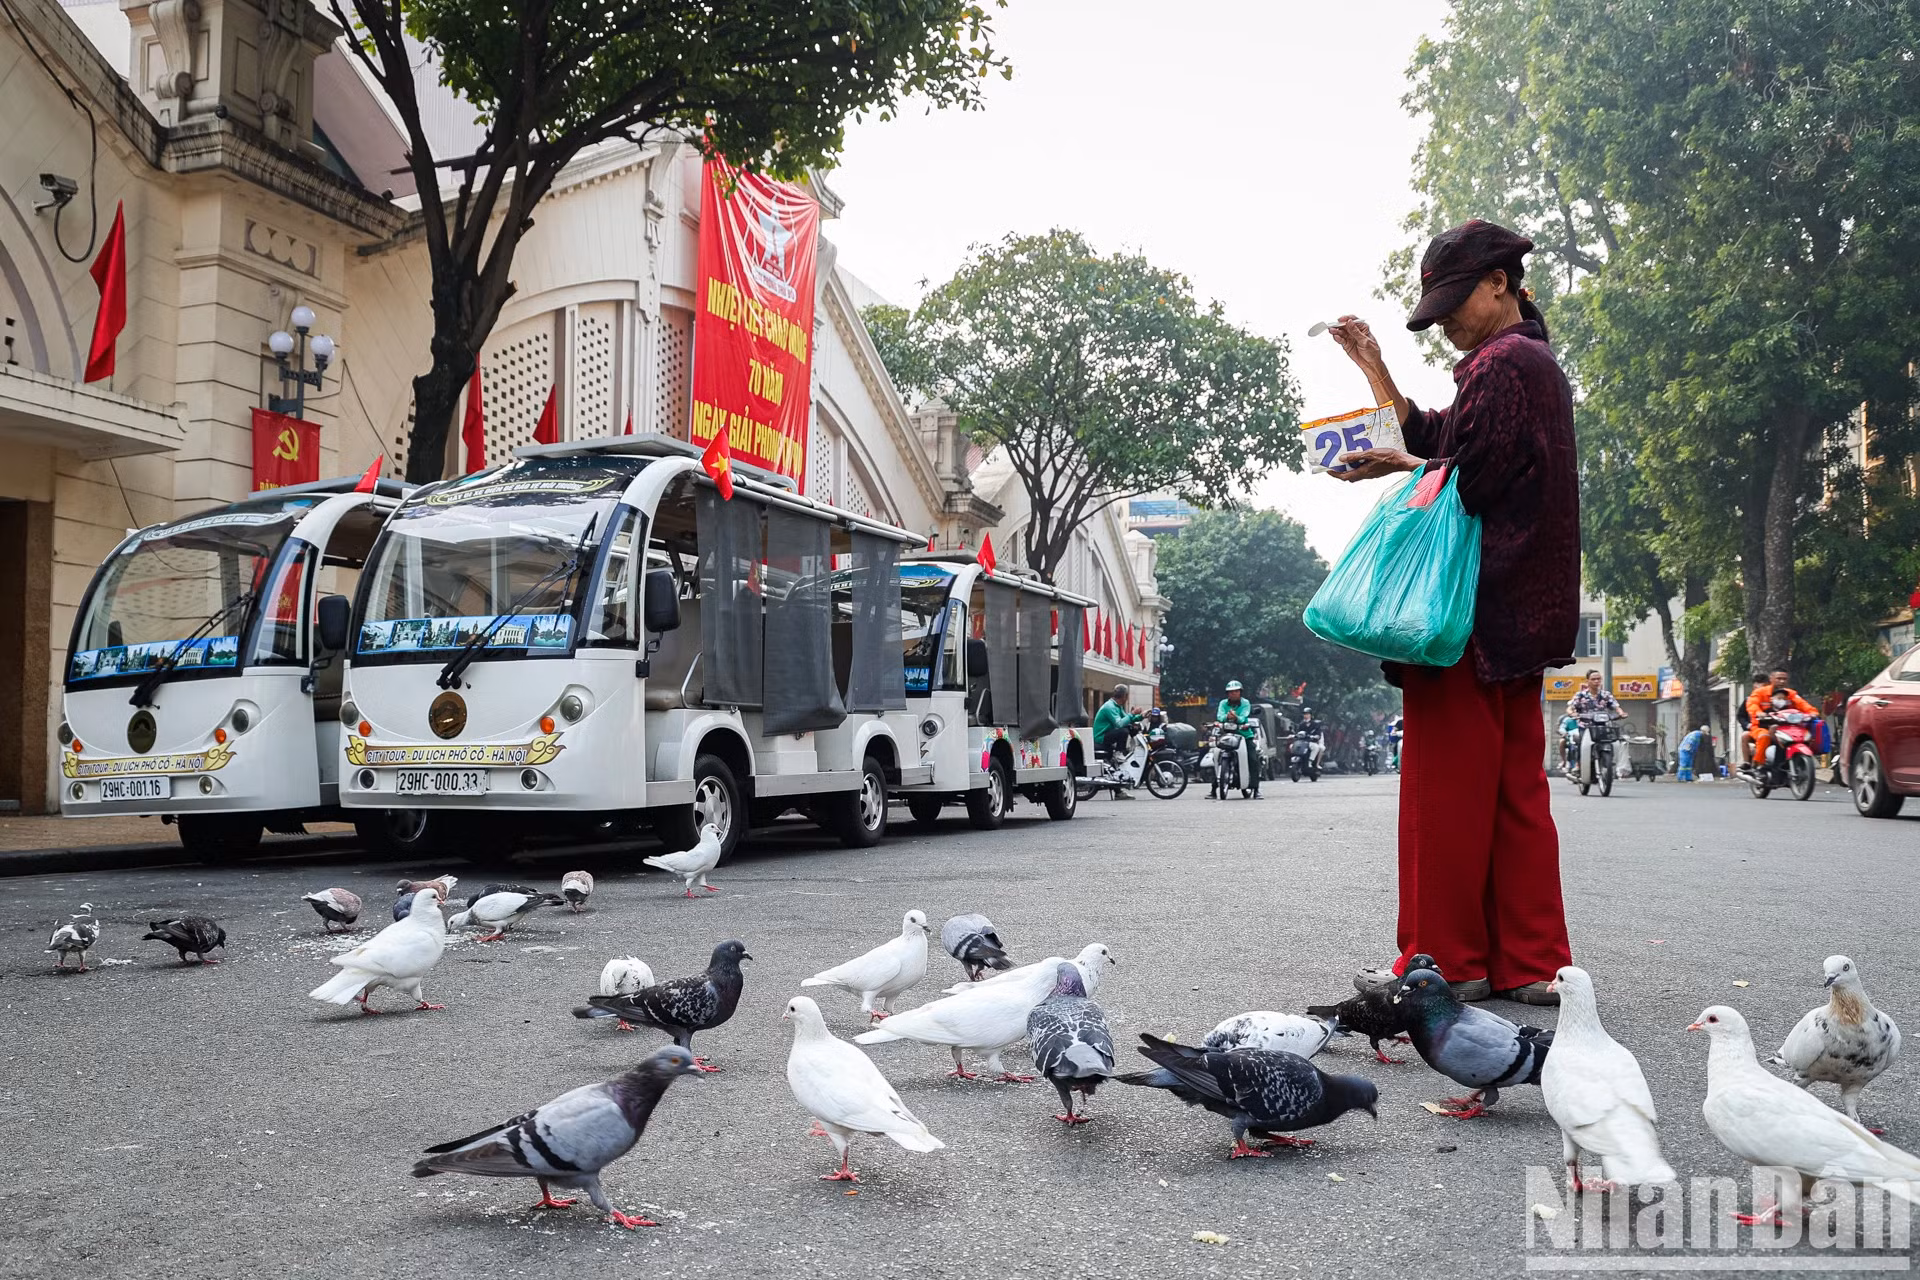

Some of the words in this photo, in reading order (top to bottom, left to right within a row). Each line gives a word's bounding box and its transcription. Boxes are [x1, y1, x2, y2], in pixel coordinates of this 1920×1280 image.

[749, 358, 762, 396] 70
[762, 361, 784, 406] NĂM
[693, 398, 727, 441] NGÀY
[729, 405, 753, 454] GIẢI
[1315, 423, 1374, 473] 25
[91, 762, 109, 774] TOUR
[112, 762, 124, 772] DU
[175, 756, 187, 769] HÀ
[366, 750, 383, 763] CITY
[384, 750, 406, 762] TOUR
[412, 750, 424, 761] DU
[426, 749, 445, 764] LỊCH
[448, 746, 471, 761] PHỐ
[492, 746, 506, 762] HÀ
[507, 747, 528, 766] NỘI
